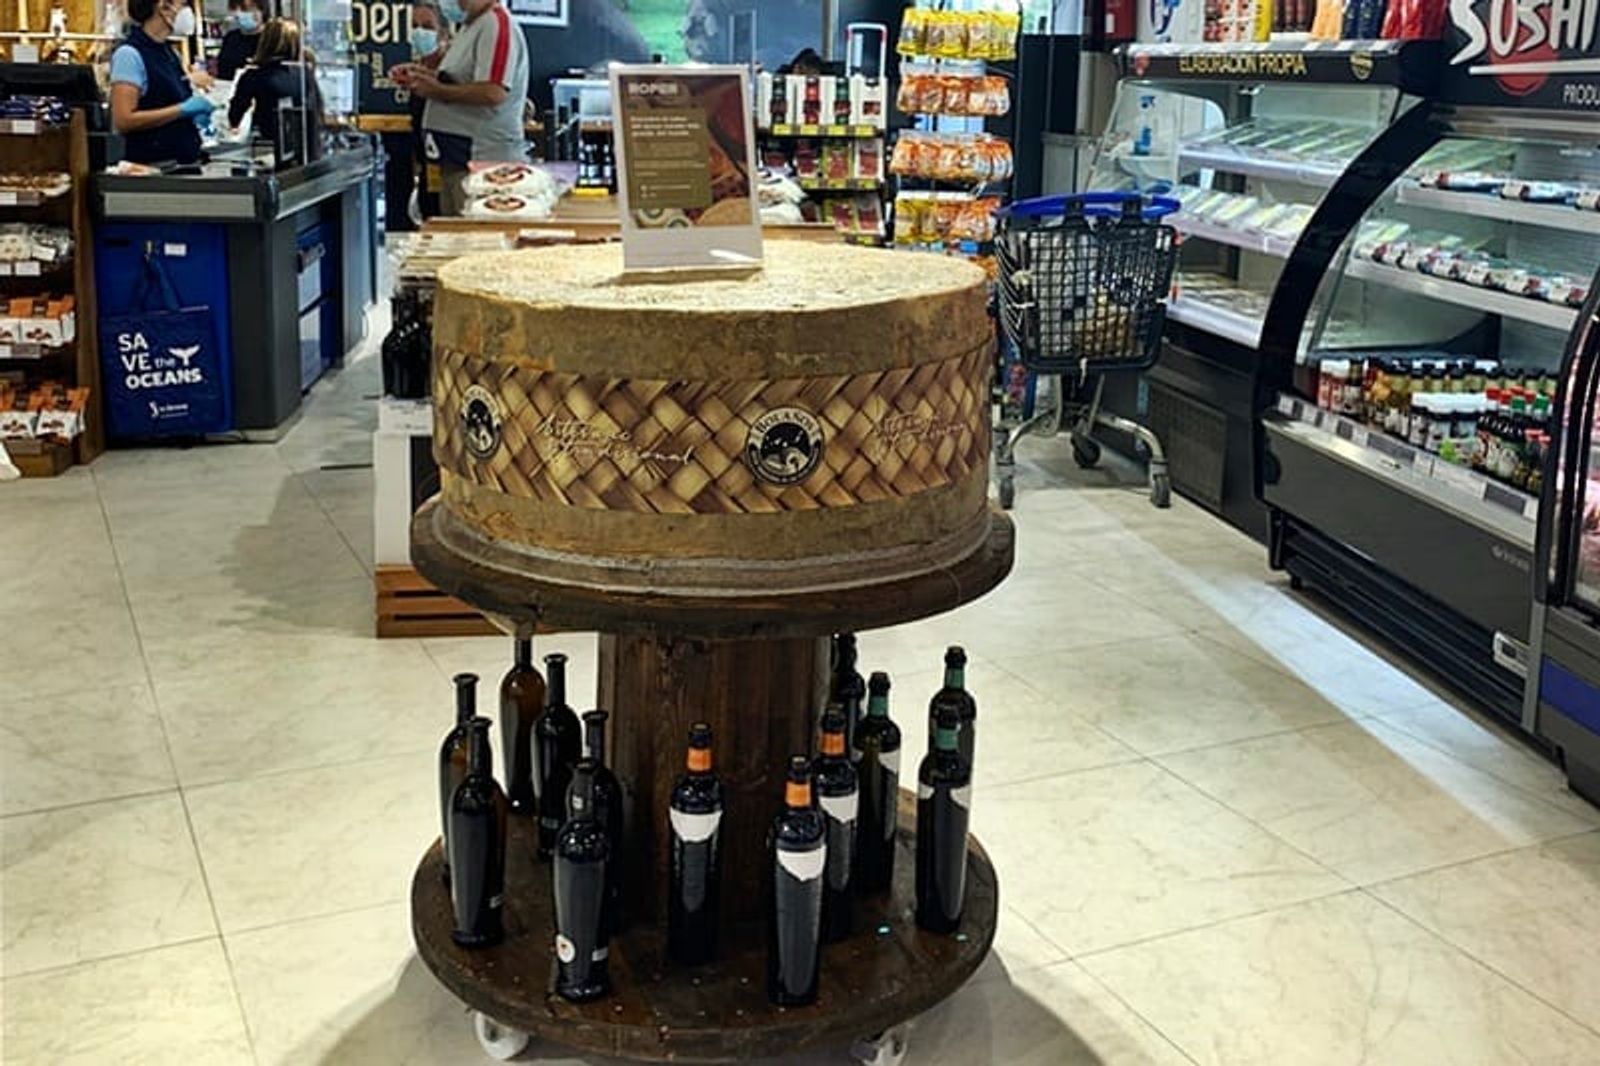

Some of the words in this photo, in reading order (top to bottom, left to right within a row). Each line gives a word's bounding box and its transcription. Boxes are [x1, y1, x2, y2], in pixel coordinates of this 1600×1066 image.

[1449, 0, 1598, 65] SUSHI
[1259, 53, 1308, 75] PROPIA
[118, 332, 149, 352] SA
[121, 352, 152, 372] VE
[125, 368, 203, 390] OCEANS
